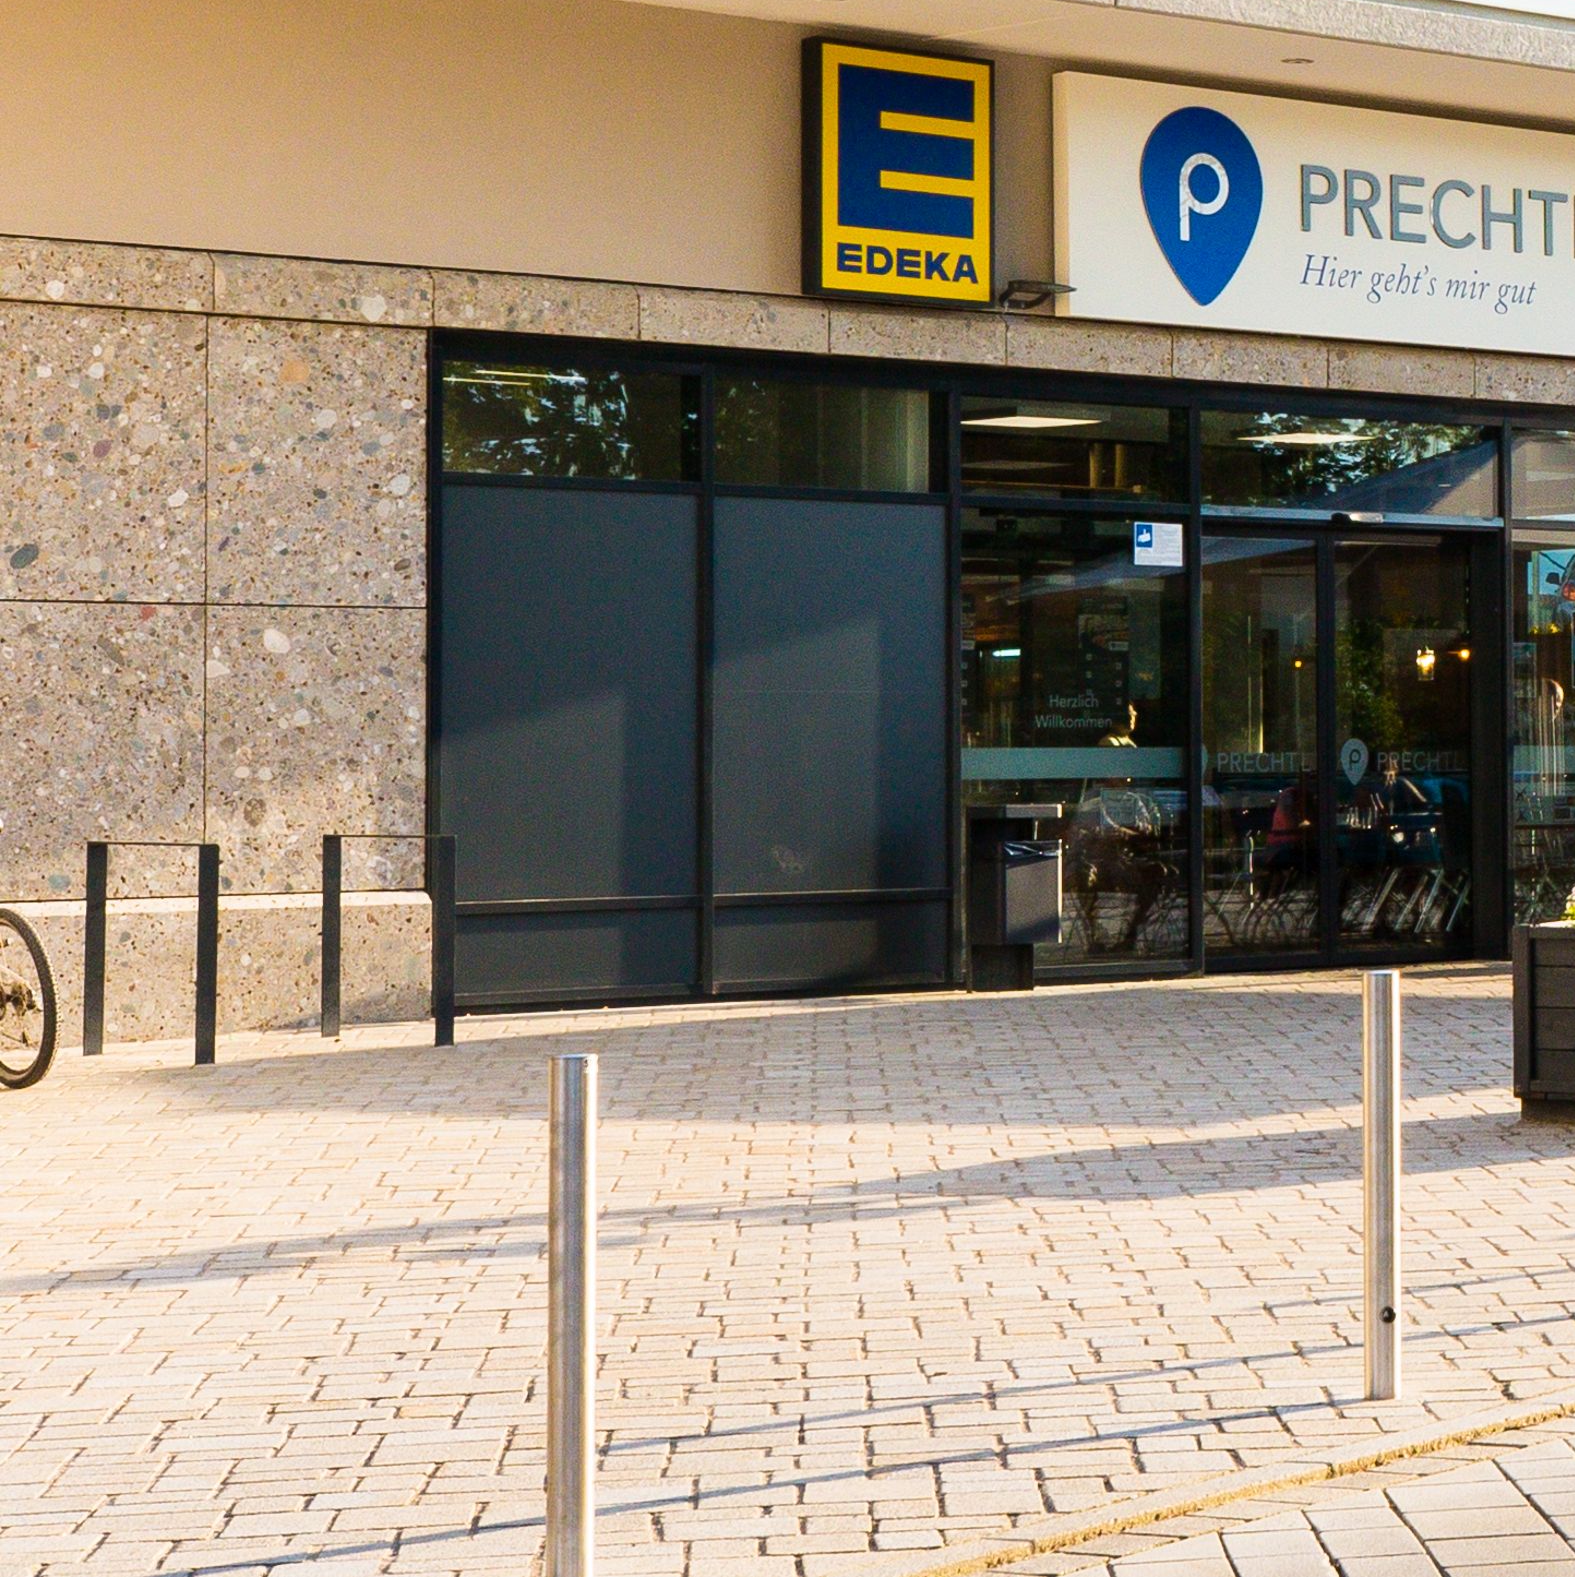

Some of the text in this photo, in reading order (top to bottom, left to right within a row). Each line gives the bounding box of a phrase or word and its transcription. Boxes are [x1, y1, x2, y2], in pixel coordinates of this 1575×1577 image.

[836, 243, 979, 285] EDEKA
[1299, 253, 1363, 289] Hier
[1445, 269, 1491, 301] mir
[1493, 280, 1537, 315] gut
[1049, 693, 1099, 709] Herzlich
[1034, 714, 1113, 729] Willkommen
[1216, 751, 1311, 773] PRECHTL
[1377, 750, 1468, 773] PRECHTL
